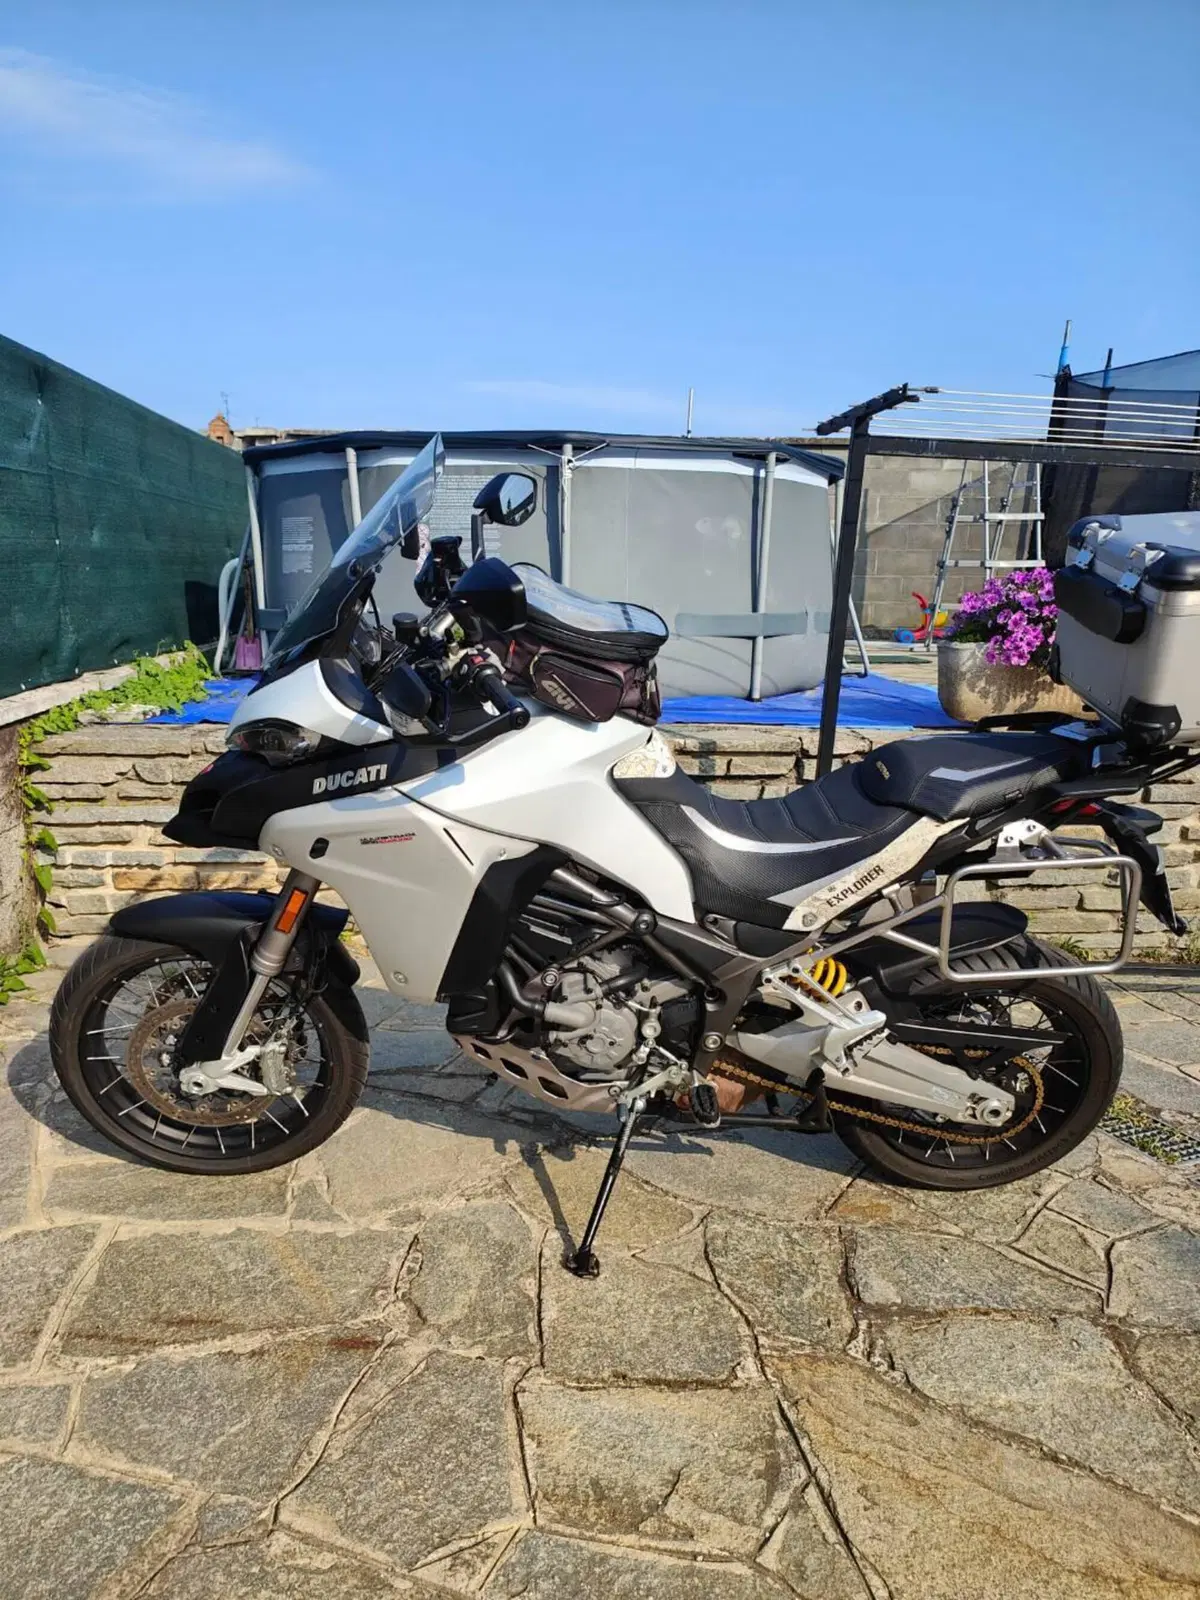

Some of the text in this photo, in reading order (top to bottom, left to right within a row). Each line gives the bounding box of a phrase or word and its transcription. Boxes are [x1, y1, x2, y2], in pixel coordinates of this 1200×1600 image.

[541, 679, 577, 711] GIVI
[312, 763, 388, 795] DUCATI
[826, 864, 885, 908] EXPLORER
